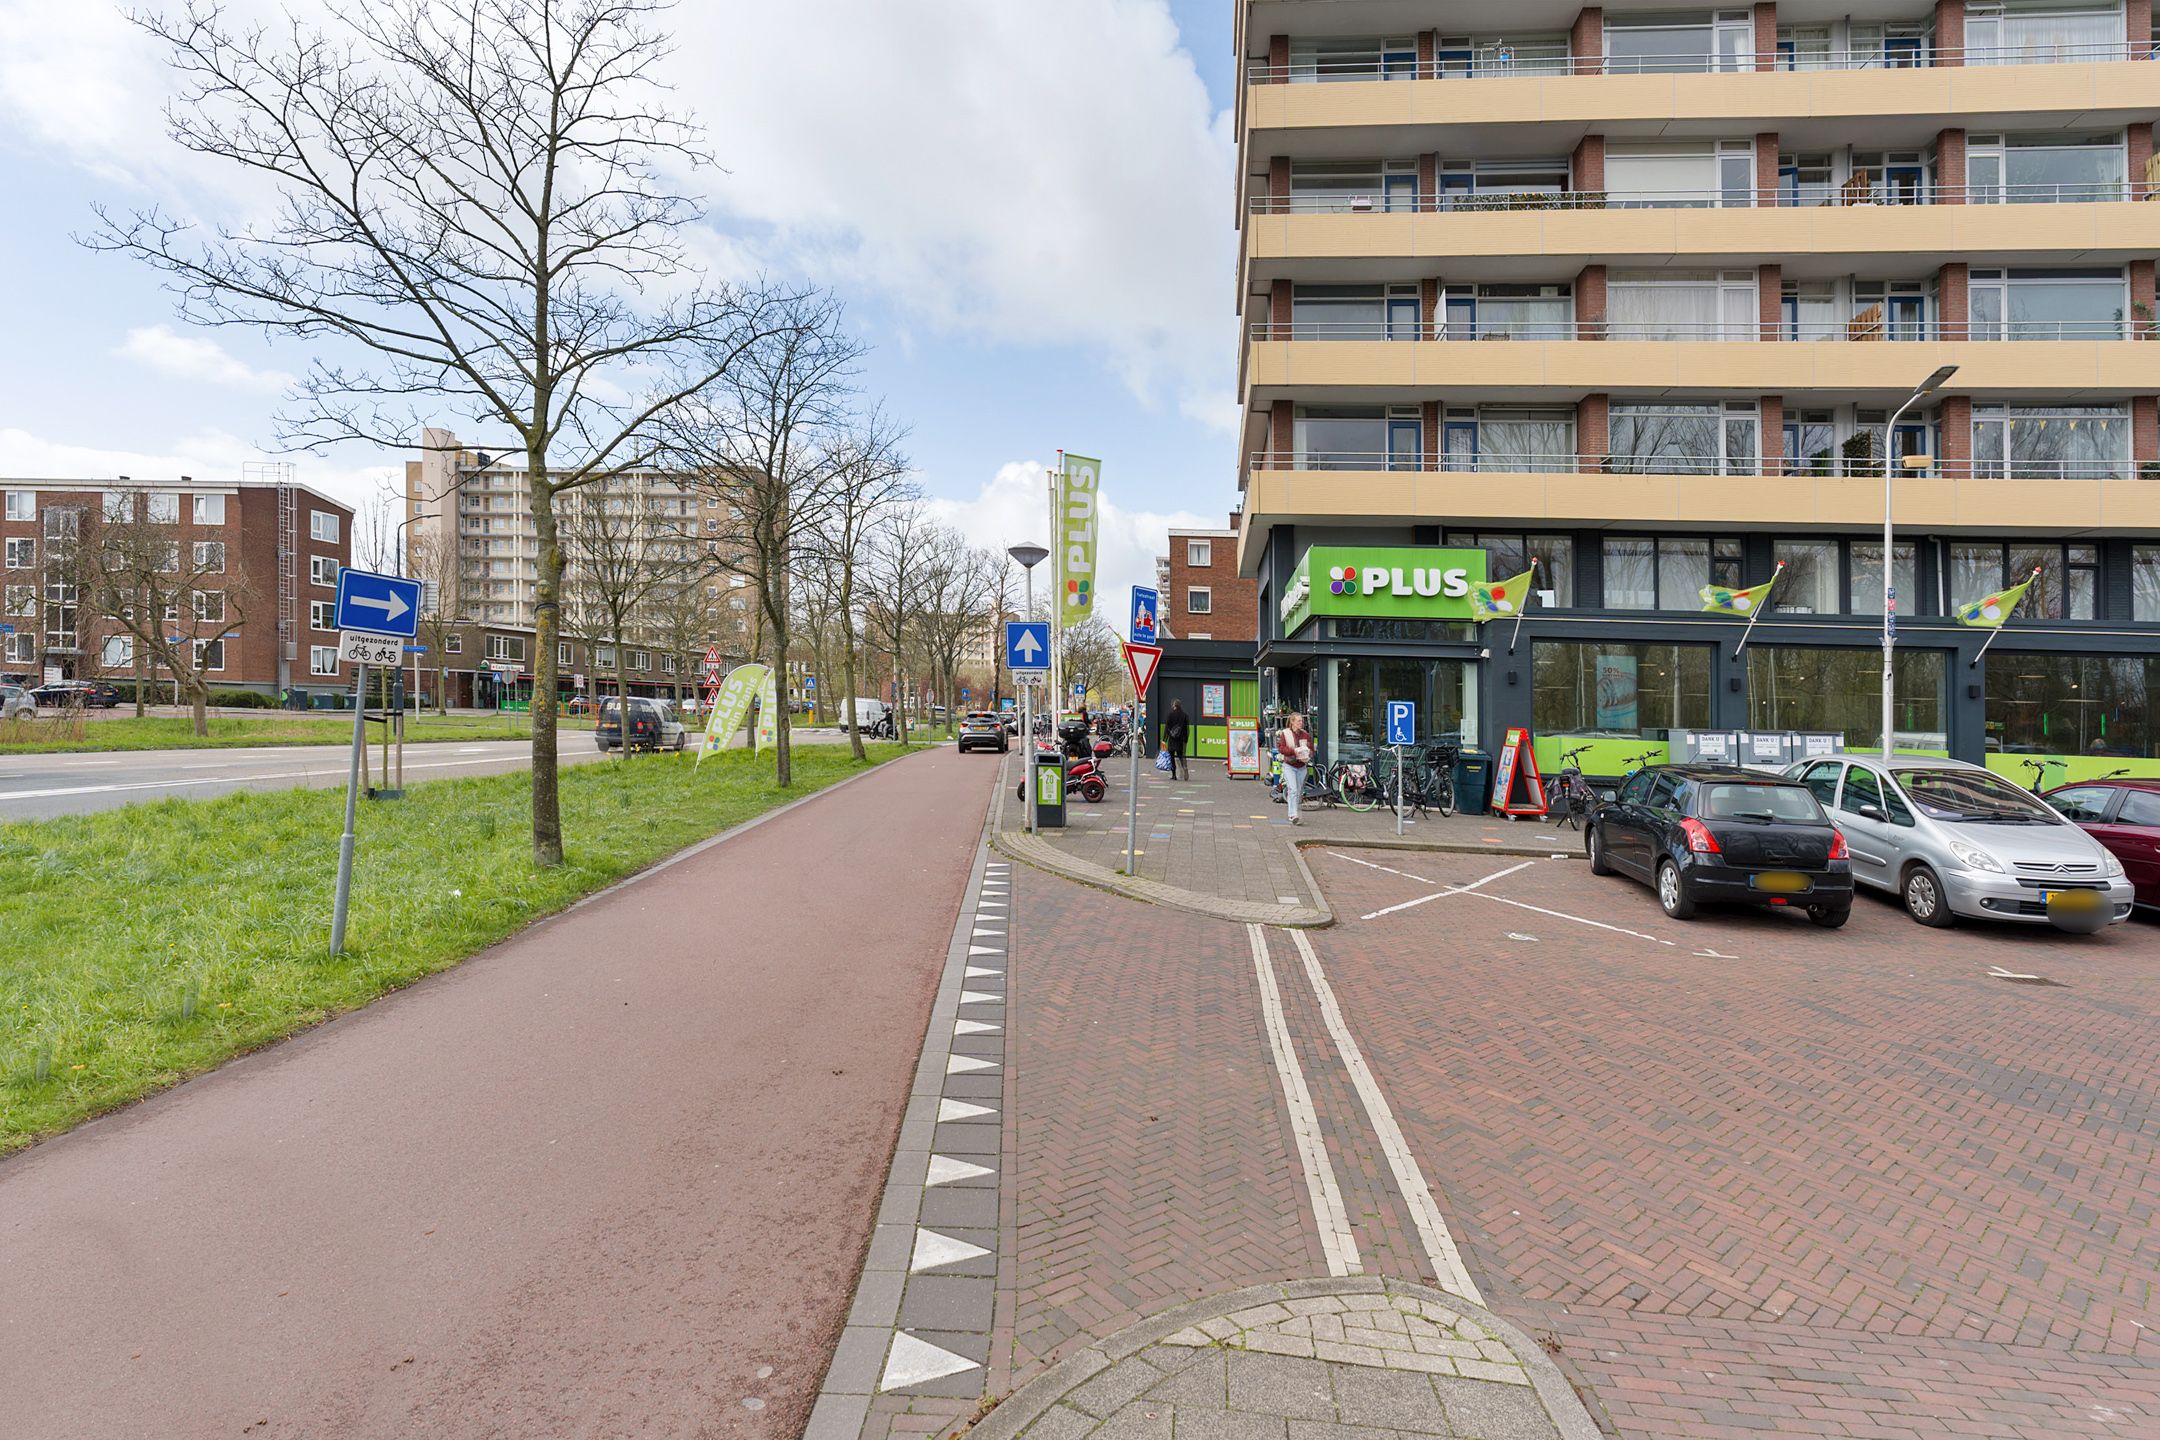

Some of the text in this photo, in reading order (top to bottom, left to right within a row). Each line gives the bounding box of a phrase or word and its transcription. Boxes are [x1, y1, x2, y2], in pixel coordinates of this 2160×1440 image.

[1067, 465, 1096, 573] PLUS
[1362, 567, 1469, 598] PLUS
[349, 635, 399, 646] uitgezonderd
[711, 678, 744, 734] PLUS
[721, 676, 757, 748] Martin Panis
[1393, 704, 1409, 726] P
[1235, 720, 1255, 728] PLUS
